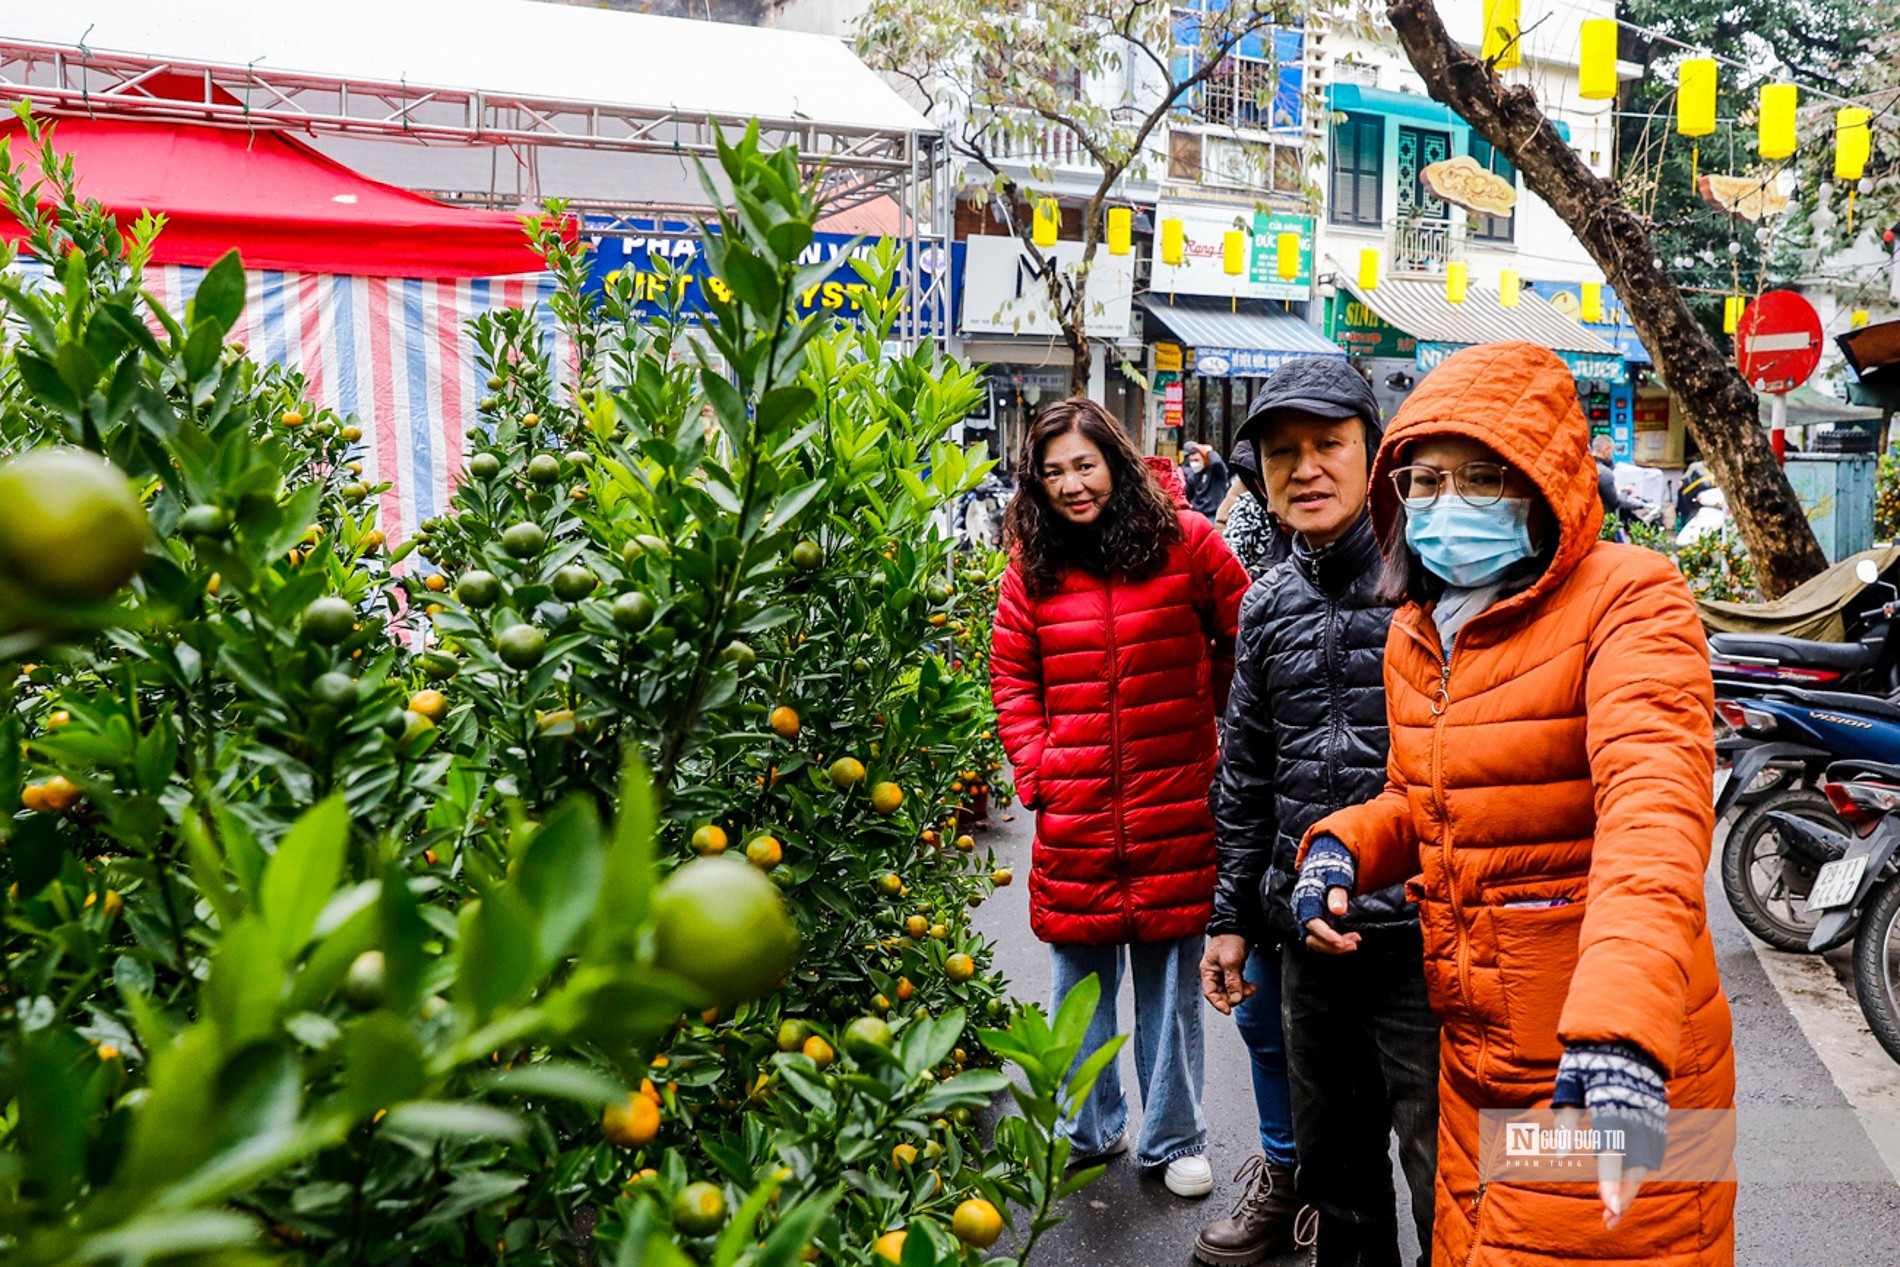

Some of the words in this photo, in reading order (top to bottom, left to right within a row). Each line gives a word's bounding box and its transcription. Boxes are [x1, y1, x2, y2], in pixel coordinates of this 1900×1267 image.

[1255, 231, 1277, 248] ĐỨC
[1572, 359, 1622, 382] JUICE
[1808, 711, 1873, 729] VISION
